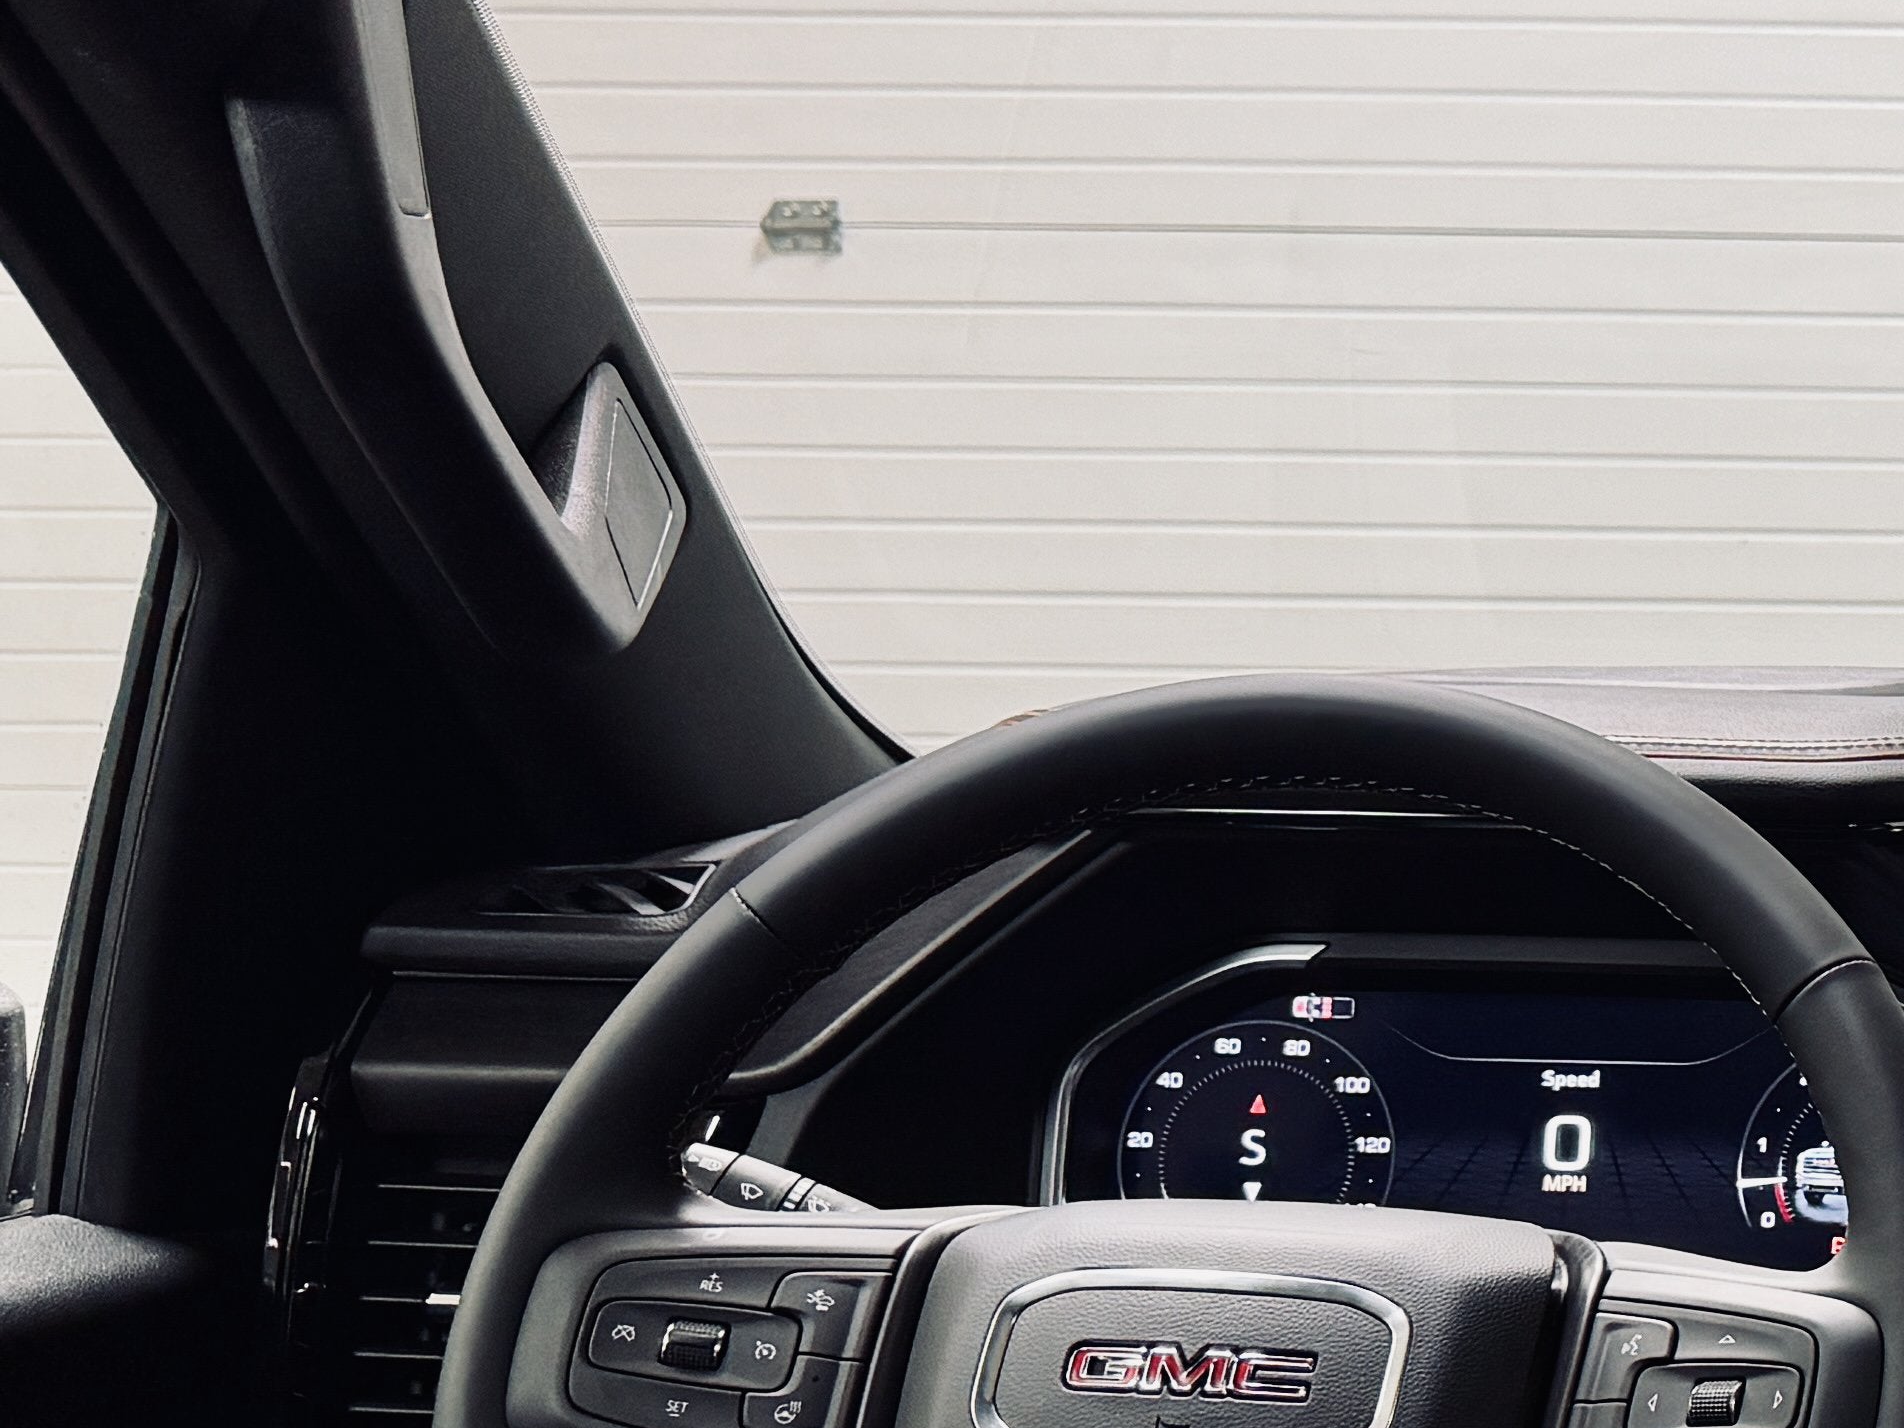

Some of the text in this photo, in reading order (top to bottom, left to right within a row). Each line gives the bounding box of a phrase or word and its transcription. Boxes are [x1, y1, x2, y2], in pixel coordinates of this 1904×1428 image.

[1213, 1038, 1242, 1055] 60
[1282, 1039, 1311, 1056] 80
[1155, 1071, 1184, 1089] 40
[1332, 1076, 1371, 1094] 100
[1540, 1069, 1601, 1091] Speed
[1126, 1131, 1154, 1149] 20
[1238, 1128, 1267, 1167] S
[1354, 1136, 1391, 1154] 120
[1542, 1114, 1592, 1172] 0
[1756, 1136, 1768, 1154] 1
[1541, 1174, 1588, 1193] MPH
[1759, 1210, 1777, 1229] 0
[699, 1279, 724, 1293] RES
[1062, 1339, 1319, 1404] GMC
[664, 1399, 690, 1414] SET
